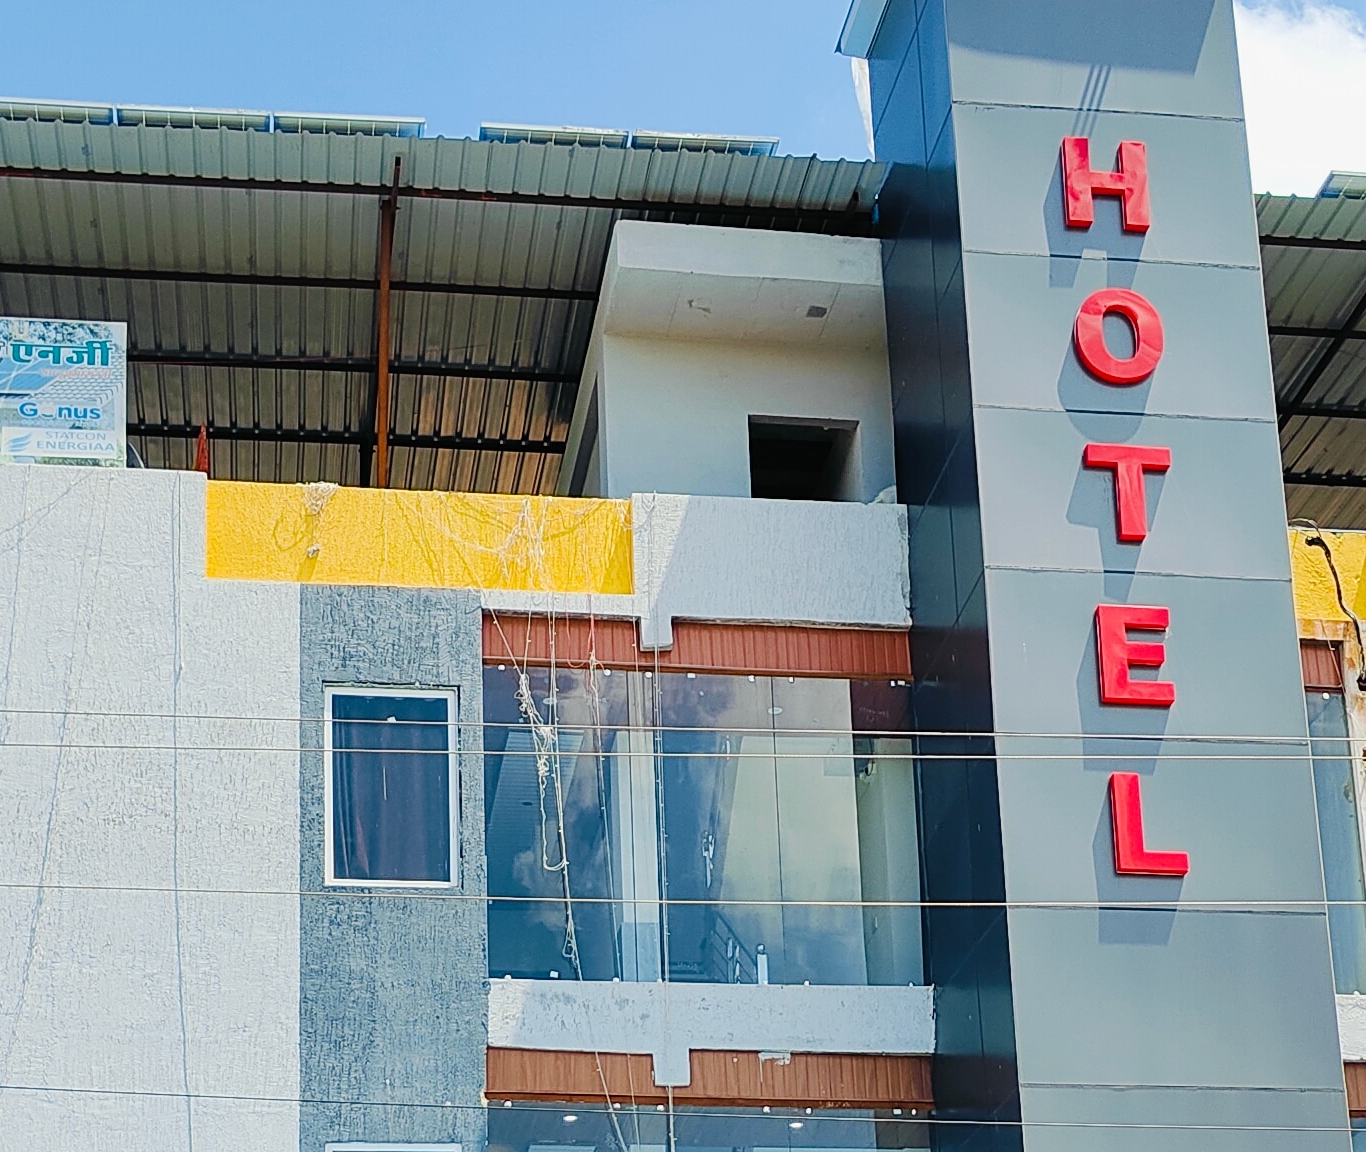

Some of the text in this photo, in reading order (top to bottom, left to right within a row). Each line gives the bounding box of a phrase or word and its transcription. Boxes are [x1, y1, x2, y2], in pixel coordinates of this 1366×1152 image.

[10, 338, 114, 367] एनर्जी
[45, 431, 106, 441] STATCON
[37, 441, 115, 451] ENERGIAA
[1061, 135, 1189, 877] HOTEL
